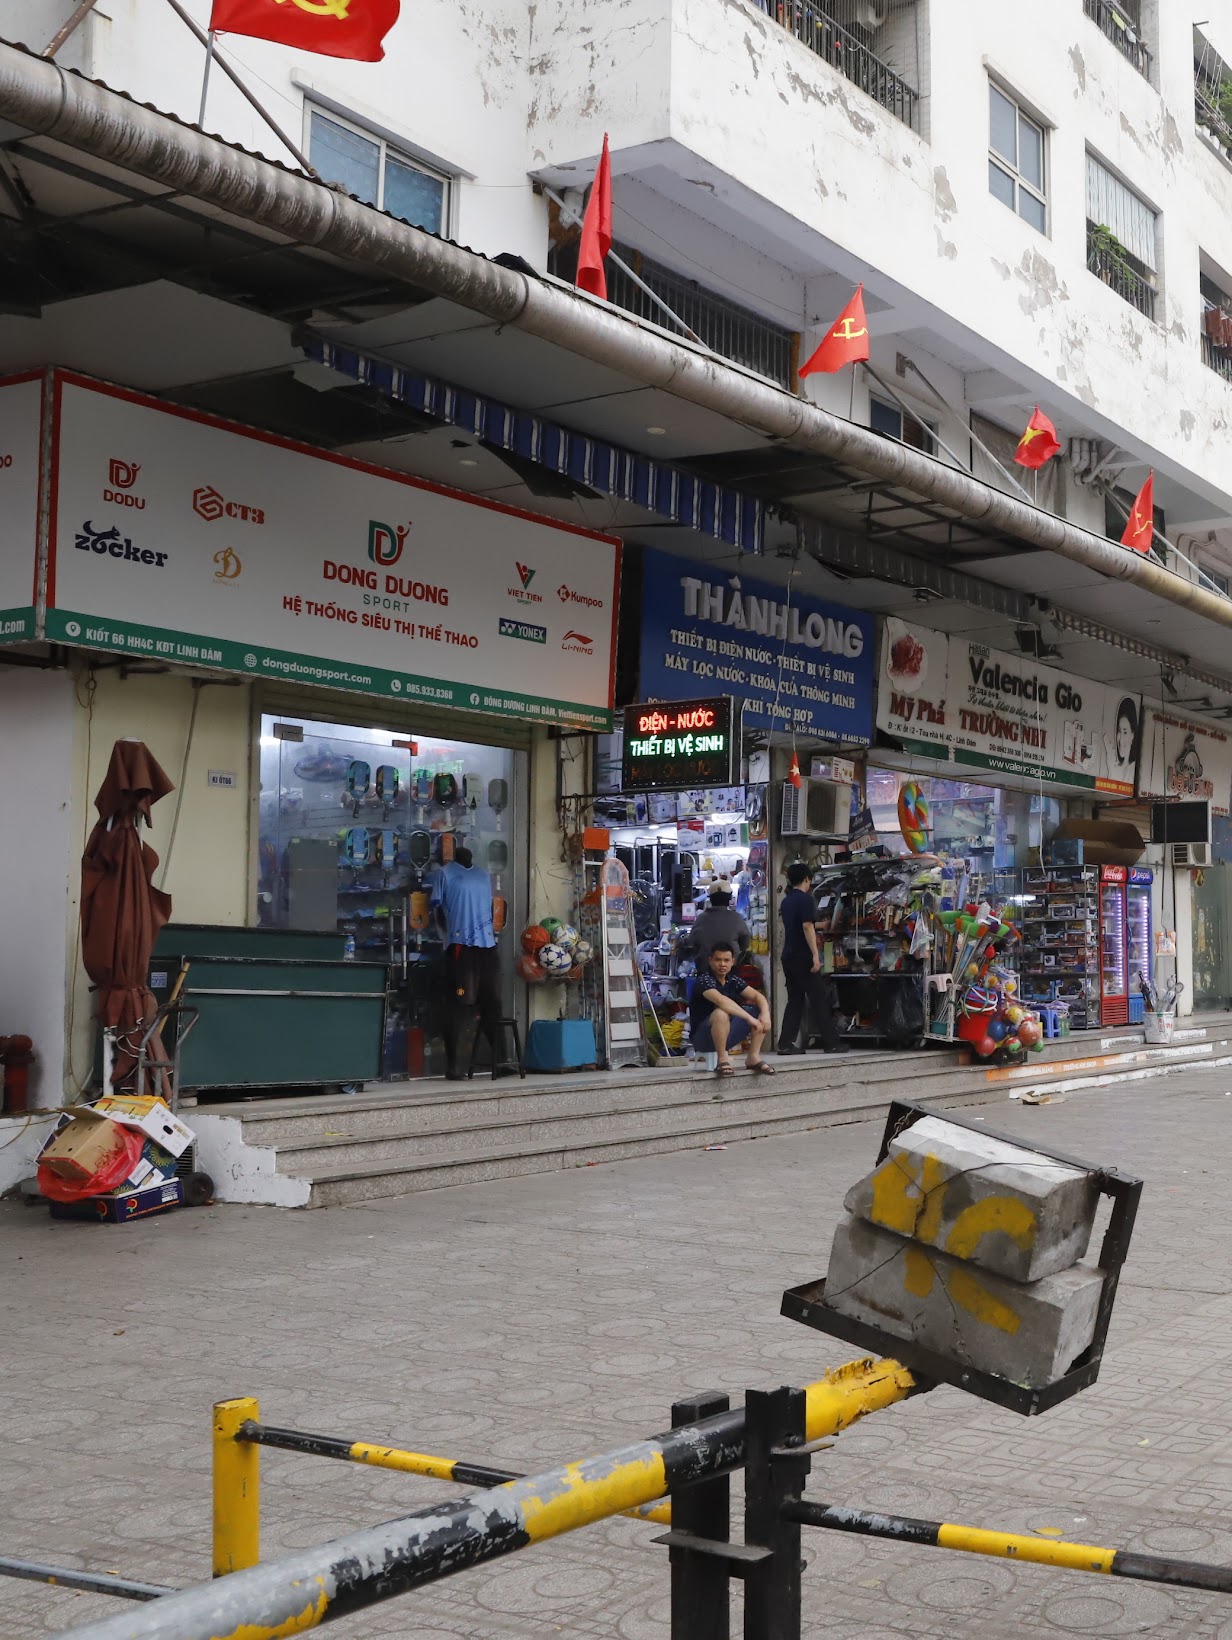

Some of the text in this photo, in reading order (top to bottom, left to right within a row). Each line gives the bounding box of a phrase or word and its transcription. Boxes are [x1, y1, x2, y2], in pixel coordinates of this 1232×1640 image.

[103, 489, 146, 510] DODU
[225, 502, 265, 525] CT3
[323, 560, 449, 606] DONG DUONG
[363, 594, 410, 613] SPORT
[571, 591, 603, 608] Kumpoo
[283, 596, 479, 648] HỆ THỐNG SIÊU THỊ THỂ THAO
[518, 625, 544, 641] YONEX
[86, 627, 222, 662] KIỐT 66 HH4C KĐT LINH ĐÀM
[561, 643, 593, 656] LI-NING
[670, 627, 855, 685] THIẾT BỊ ĐIỆN NƯỚC THIẾT BỊ VỆ SINH
[262, 657, 372, 685] dongduongsport.com
[665, 651, 855, 710] MÁY LỌC NƯỚC KHÓA CỬA THÔNG MINH
[968, 657, 1082, 712] Valencia Gio
[406, 682, 454, 700] 085.933.8368
[526, 703, 540, 714] LINH
[744, 696, 813, 726] KHÍ TỔNG HỢP
[890, 692, 915, 722] Mỹ
[639, 712, 668, 734] ĐIỆN
[677, 708, 714, 728] NƯỚC
[958, 707, 1047, 750] TRƯỜNG NHI
[630, 733, 724, 758] THIẾT BỊ VỆ SINH
